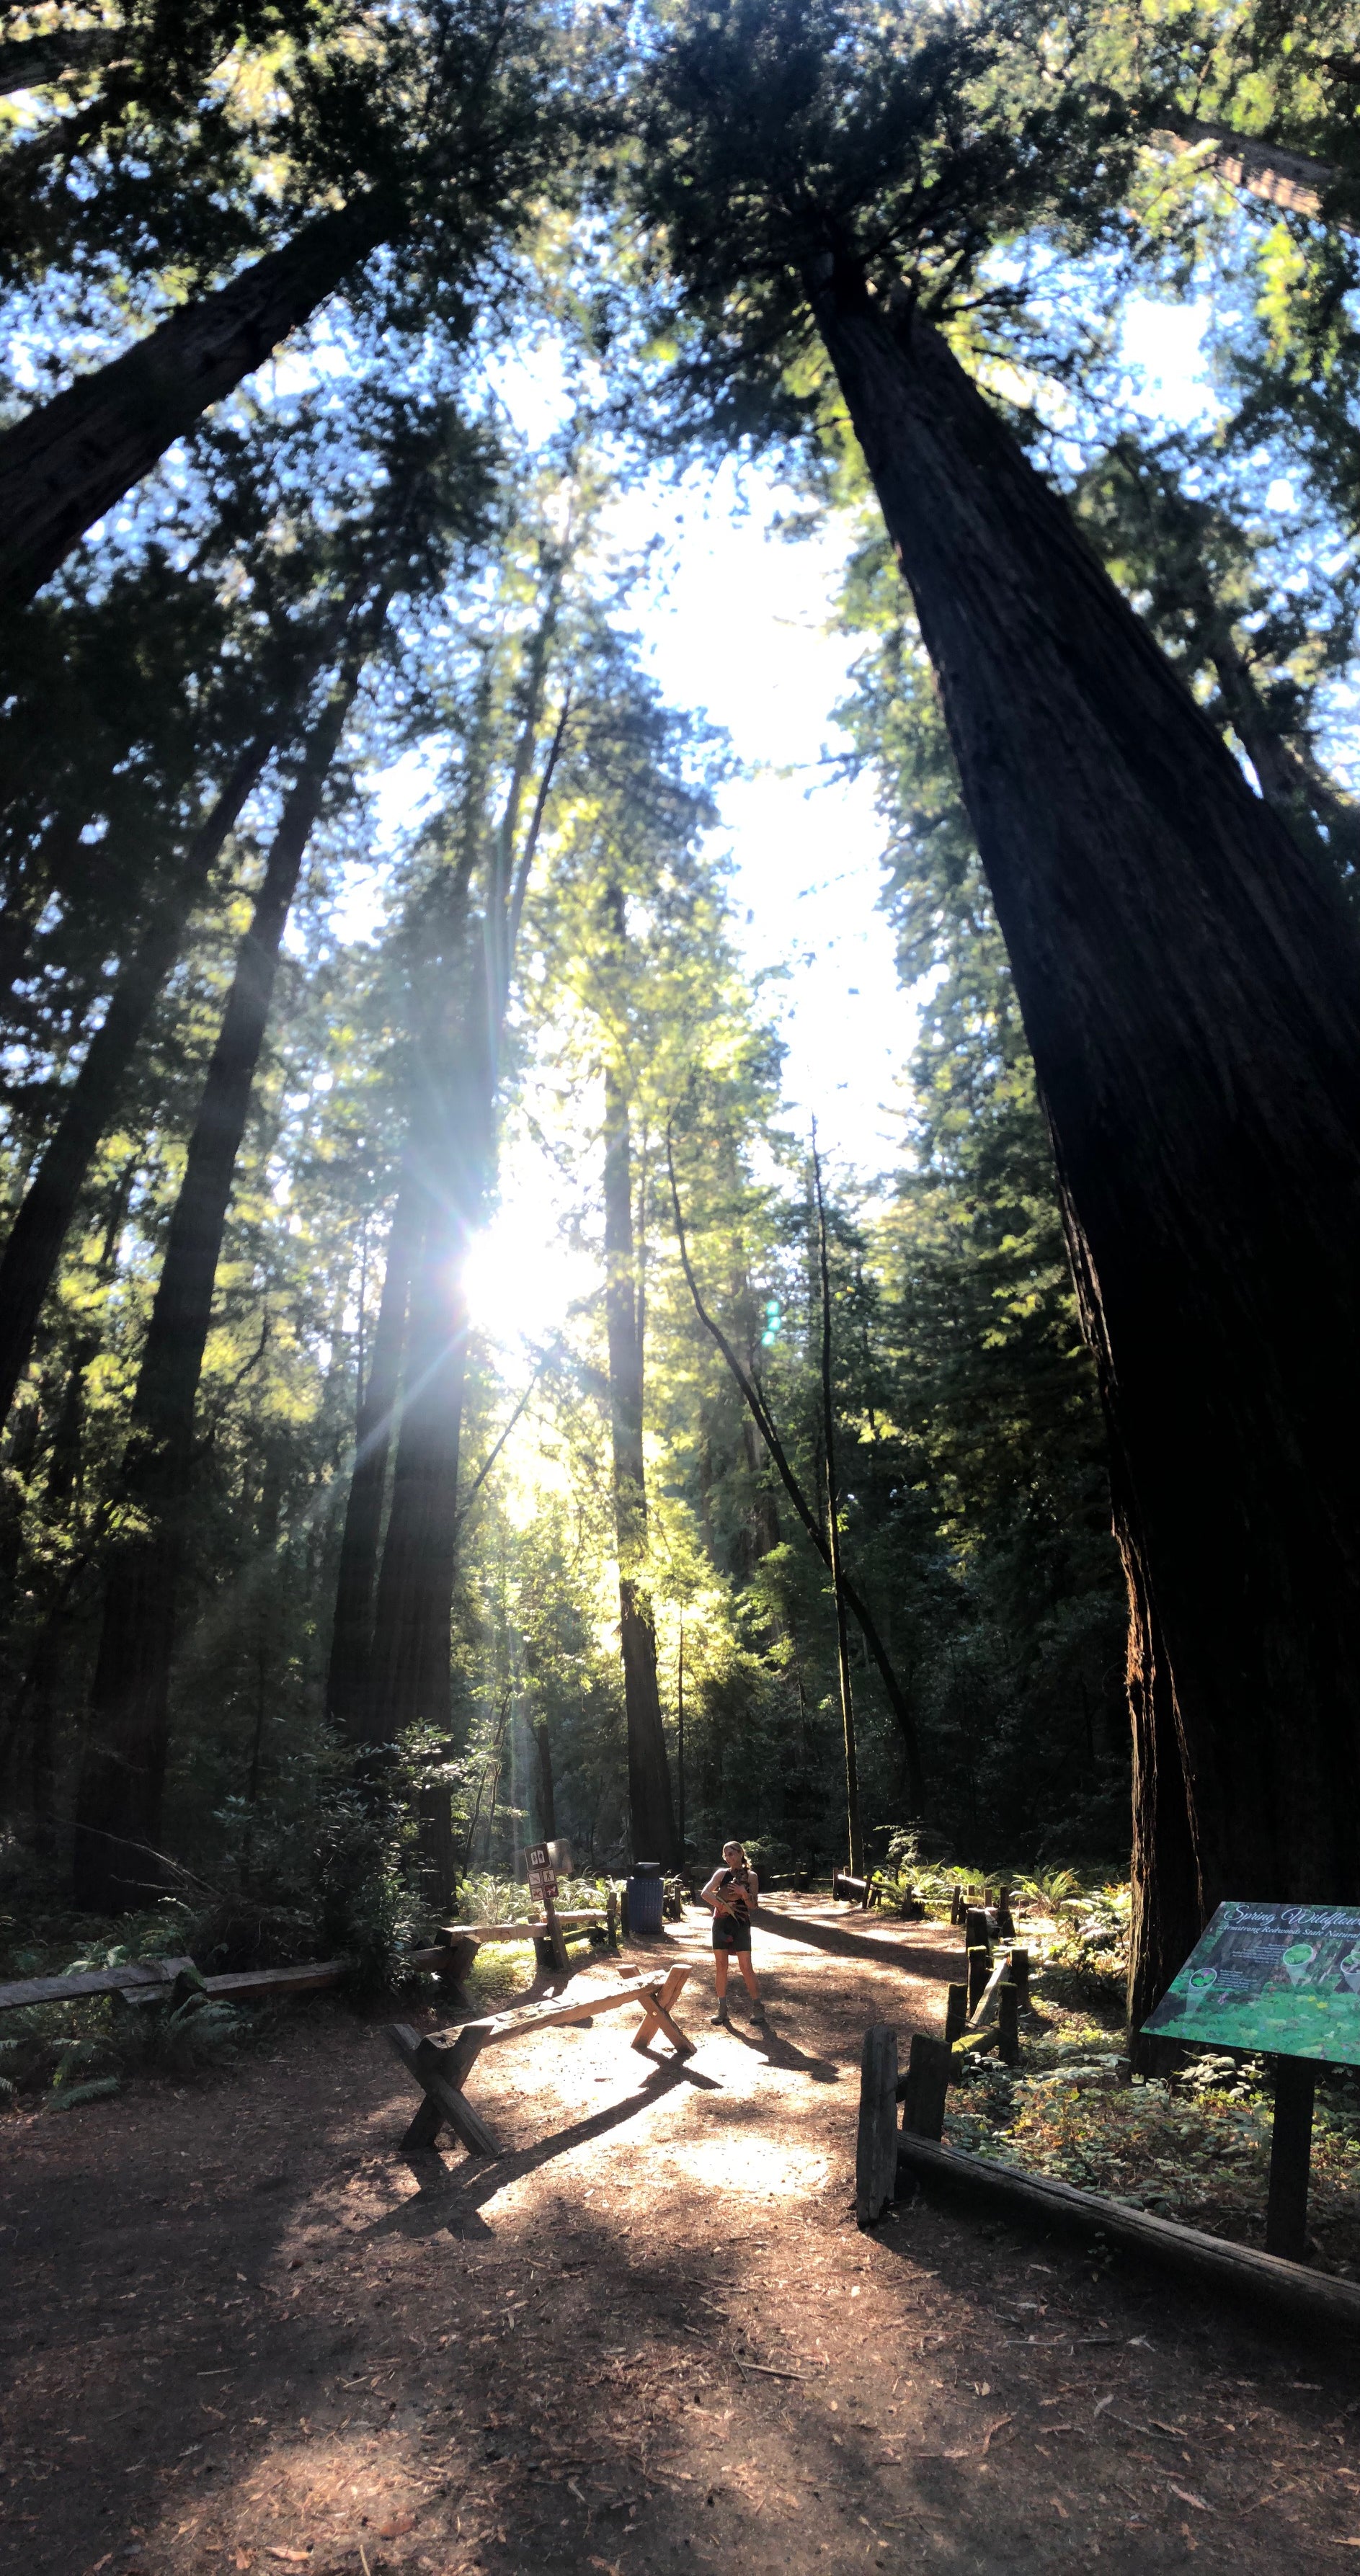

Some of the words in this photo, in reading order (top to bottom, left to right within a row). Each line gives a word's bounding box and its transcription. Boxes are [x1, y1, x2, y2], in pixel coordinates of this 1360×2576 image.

[1223, 1904, 1276, 1926] Spring
[1219, 1924, 1261, 1934] Armstrong
[1261, 1925, 1301, 1935] Redwoods
[1325, 1930, 1360, 1938] Natural
